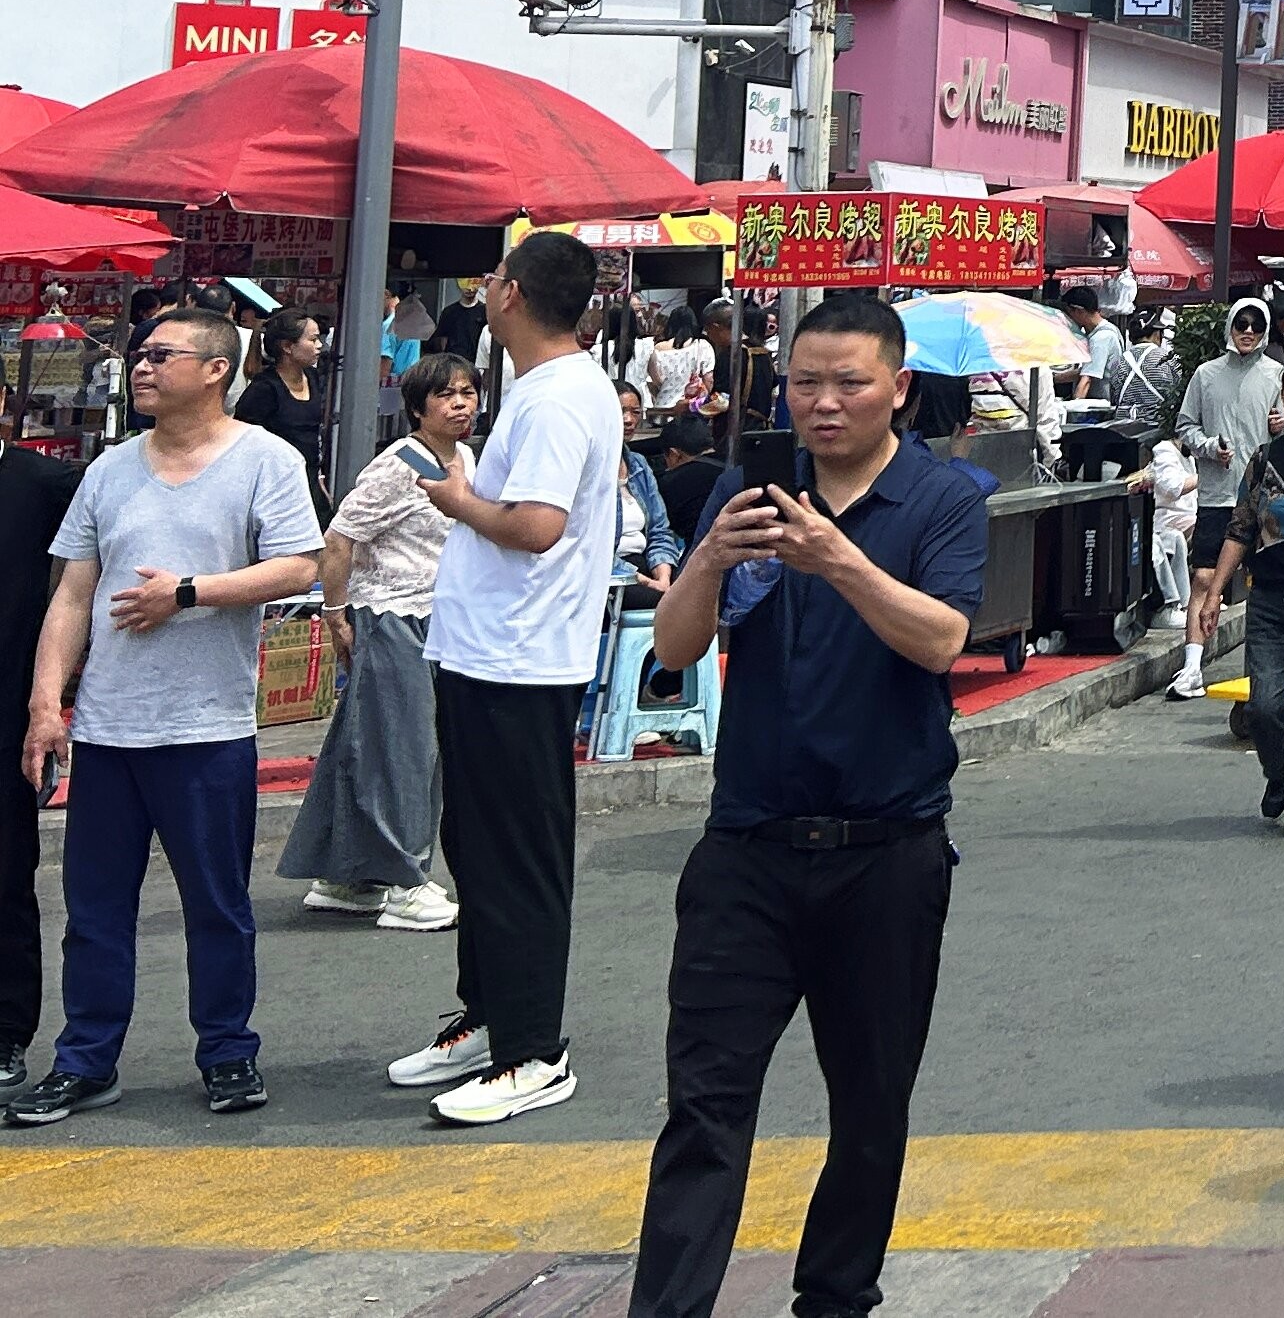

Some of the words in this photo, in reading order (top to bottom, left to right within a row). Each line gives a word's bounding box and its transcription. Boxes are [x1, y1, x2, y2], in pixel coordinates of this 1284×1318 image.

[186, 25, 267, 53] MINI
[1127, 101, 1220, 159] BABIBOY
[577, 224, 661, 244] 看男科
[740, 200, 882, 242] 新奥尔良烤翅
[896, 199, 1039, 246] 新奥尔良烤翅
